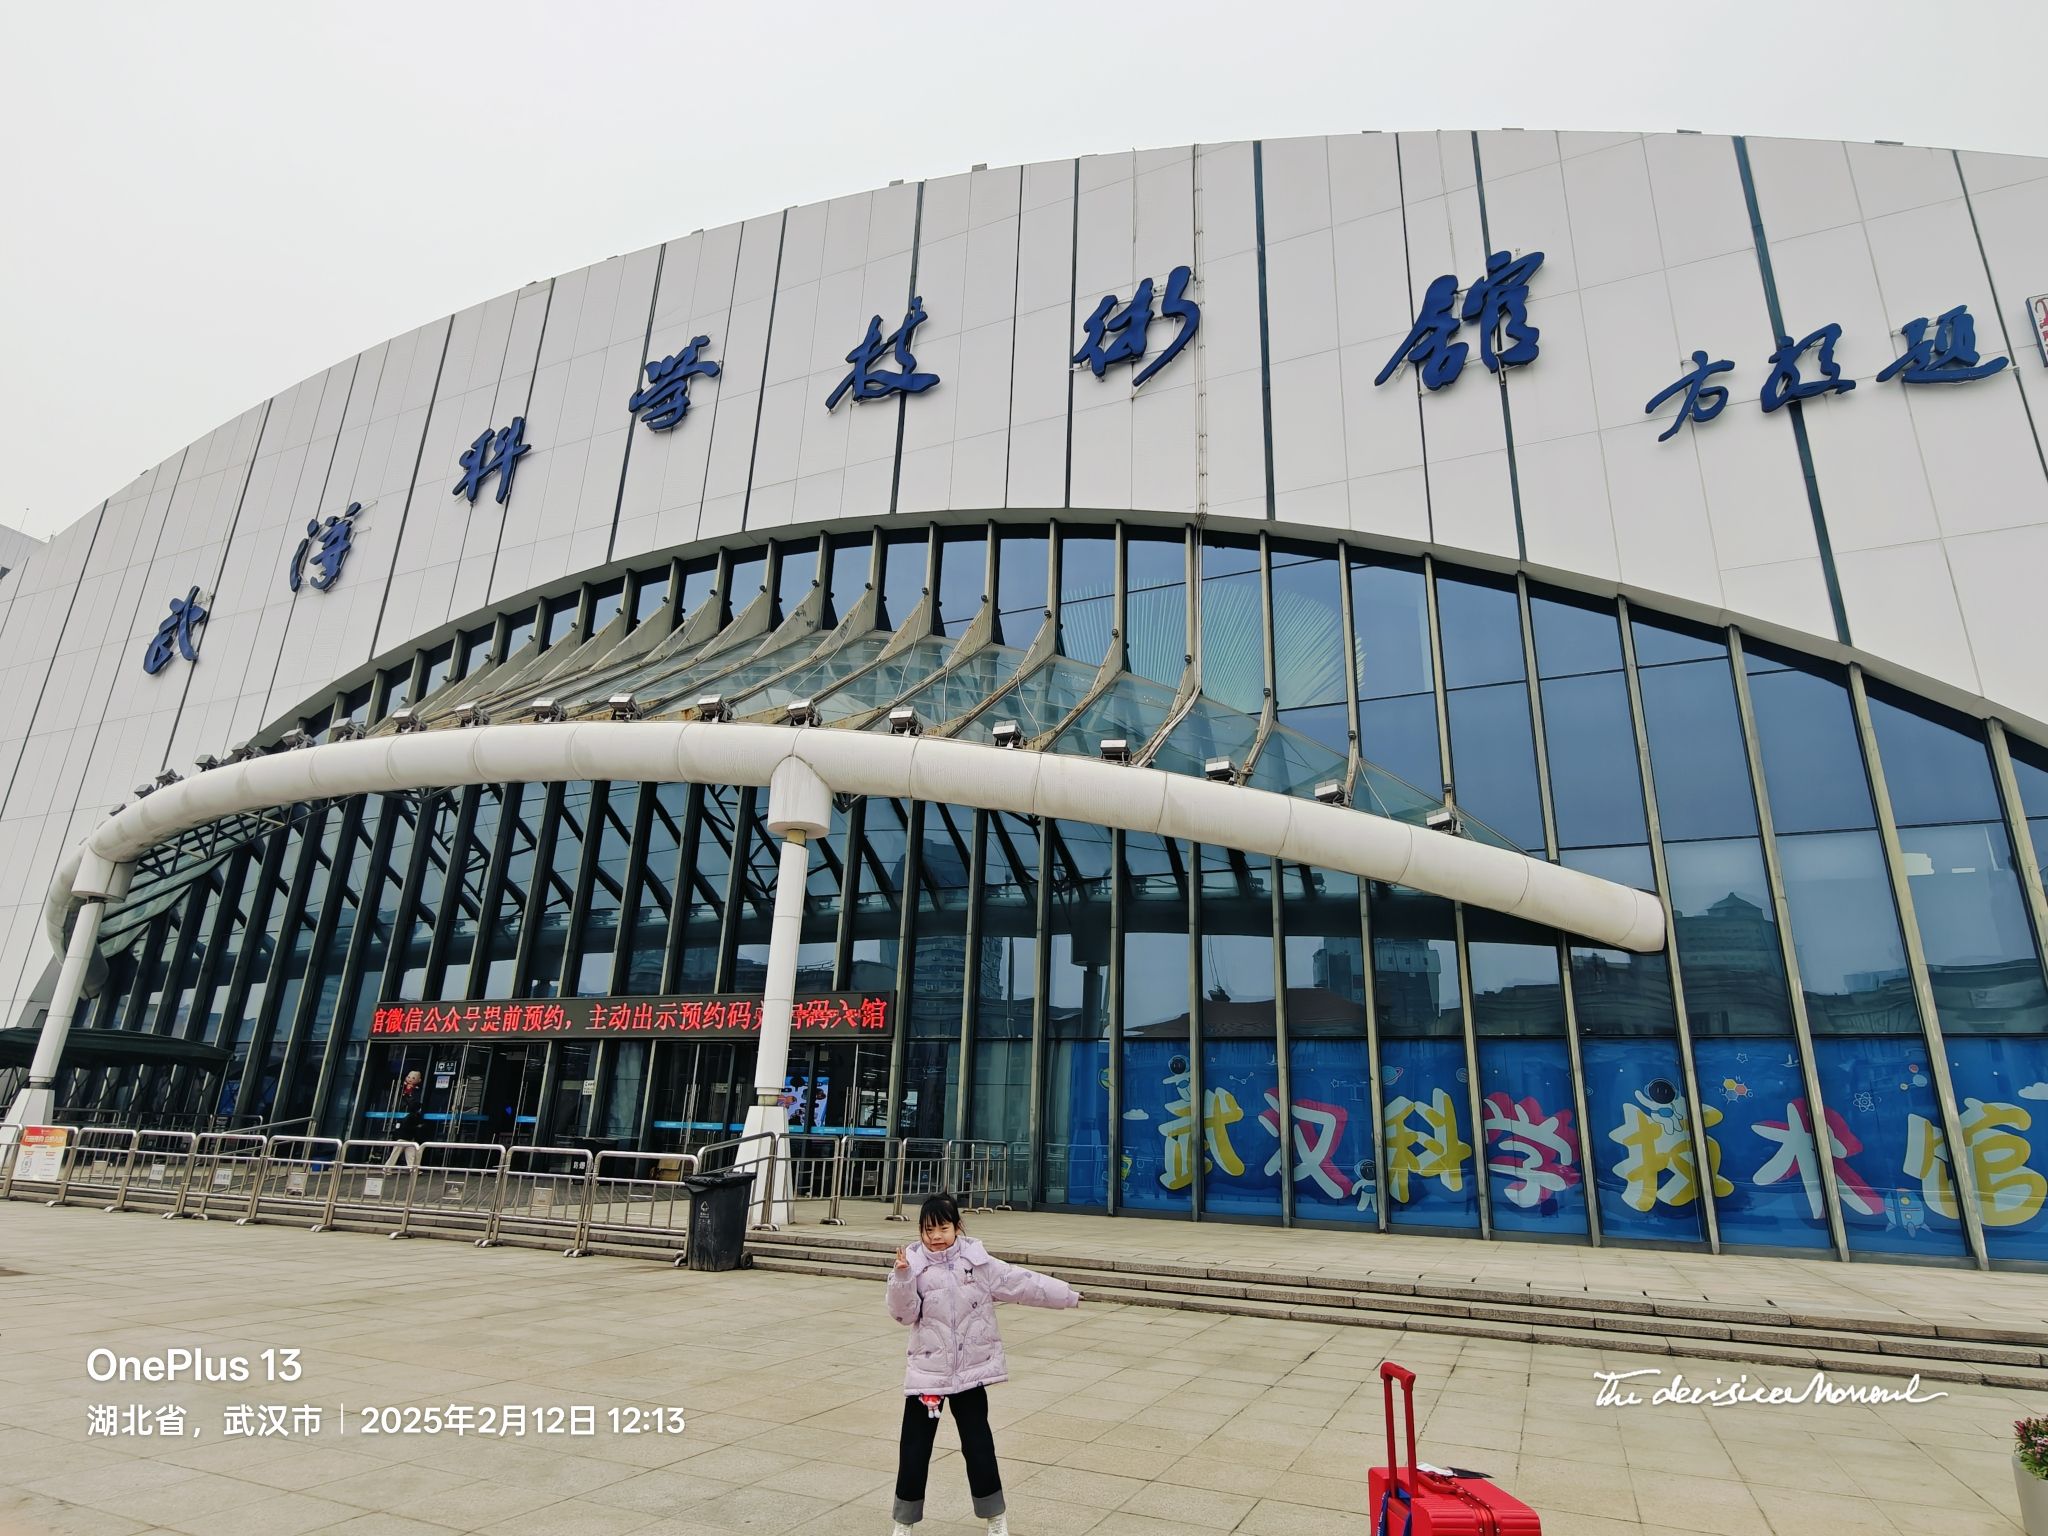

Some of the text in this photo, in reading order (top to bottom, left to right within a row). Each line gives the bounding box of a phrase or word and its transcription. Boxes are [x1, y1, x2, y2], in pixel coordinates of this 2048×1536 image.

[1158, 1087, 2048, 1227] 武汉科学技术馆
